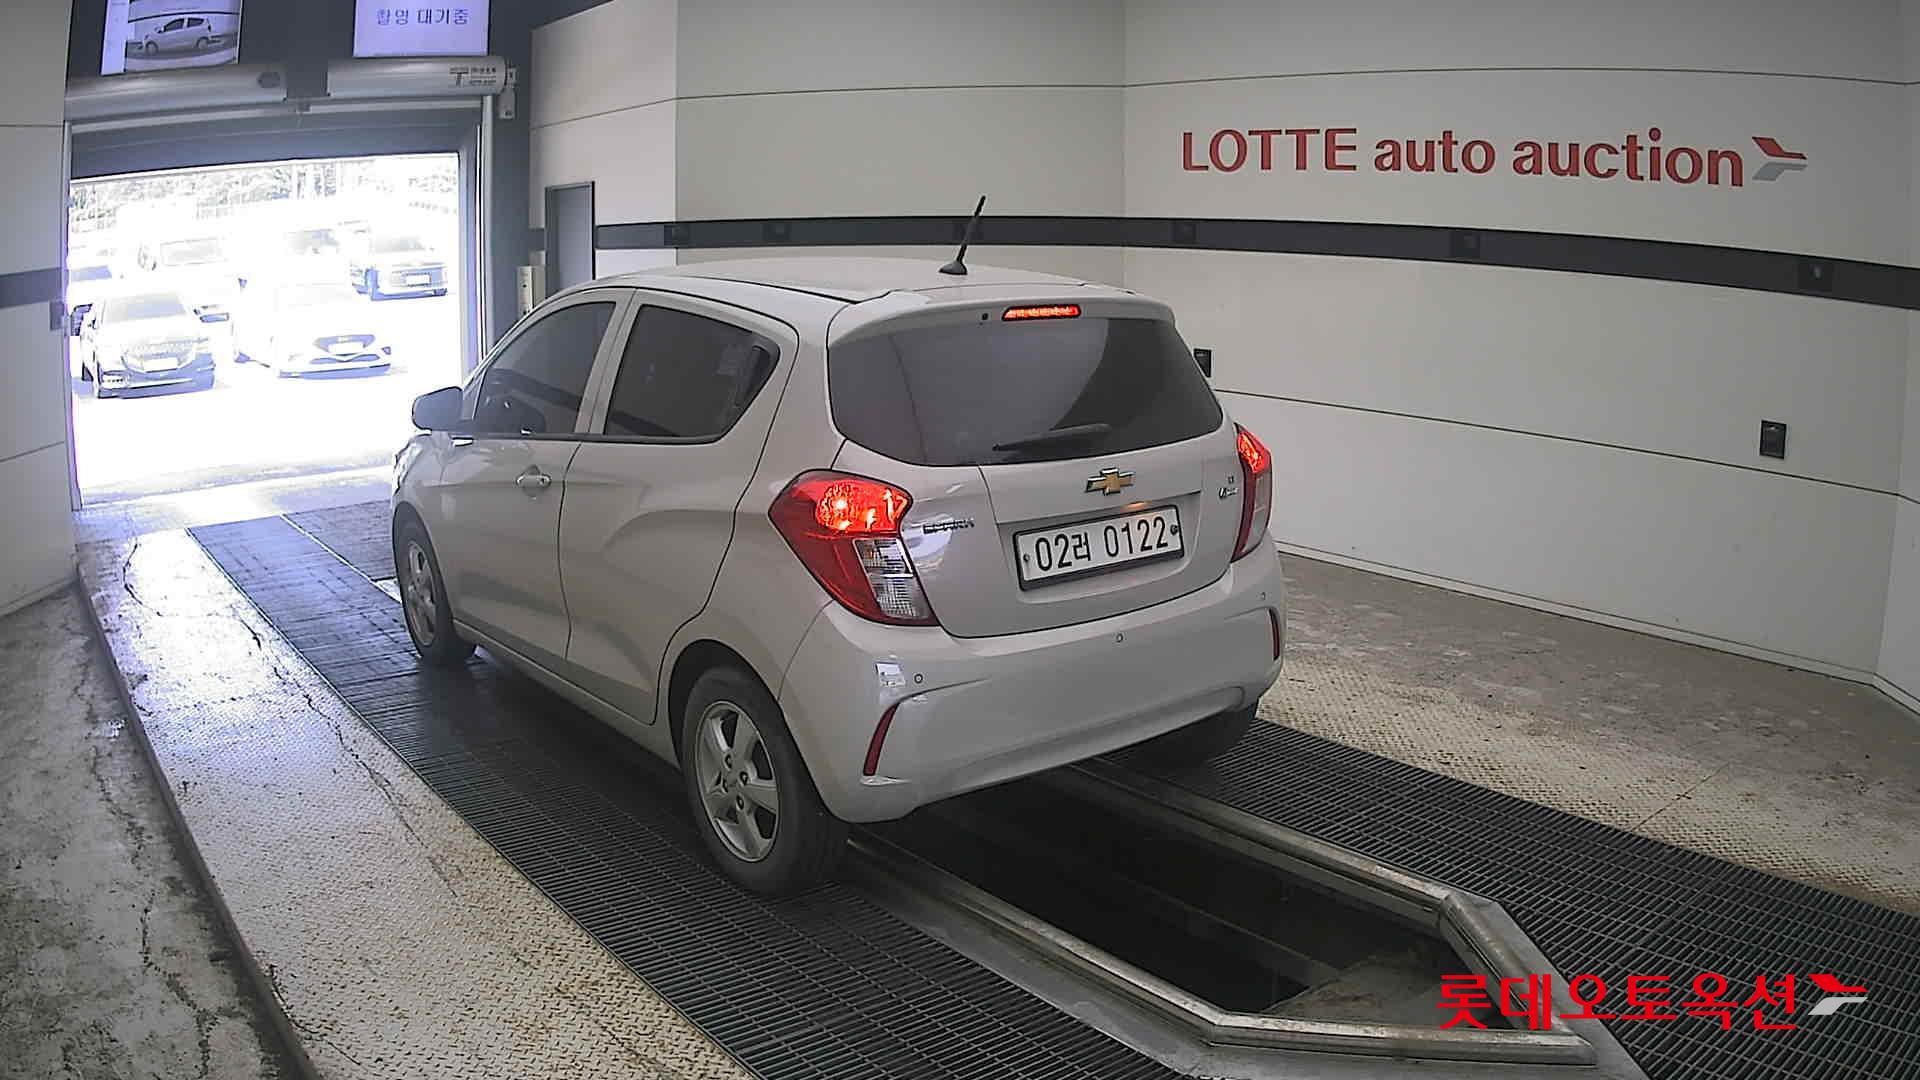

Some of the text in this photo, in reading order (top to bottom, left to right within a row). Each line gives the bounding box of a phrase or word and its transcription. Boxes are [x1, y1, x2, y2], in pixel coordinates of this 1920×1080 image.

[417, 8, 469, 25] 대기중
[1183, 127, 1743, 185] LOTTE auto auction
[1034, 516, 1169, 571] 02러 0122
